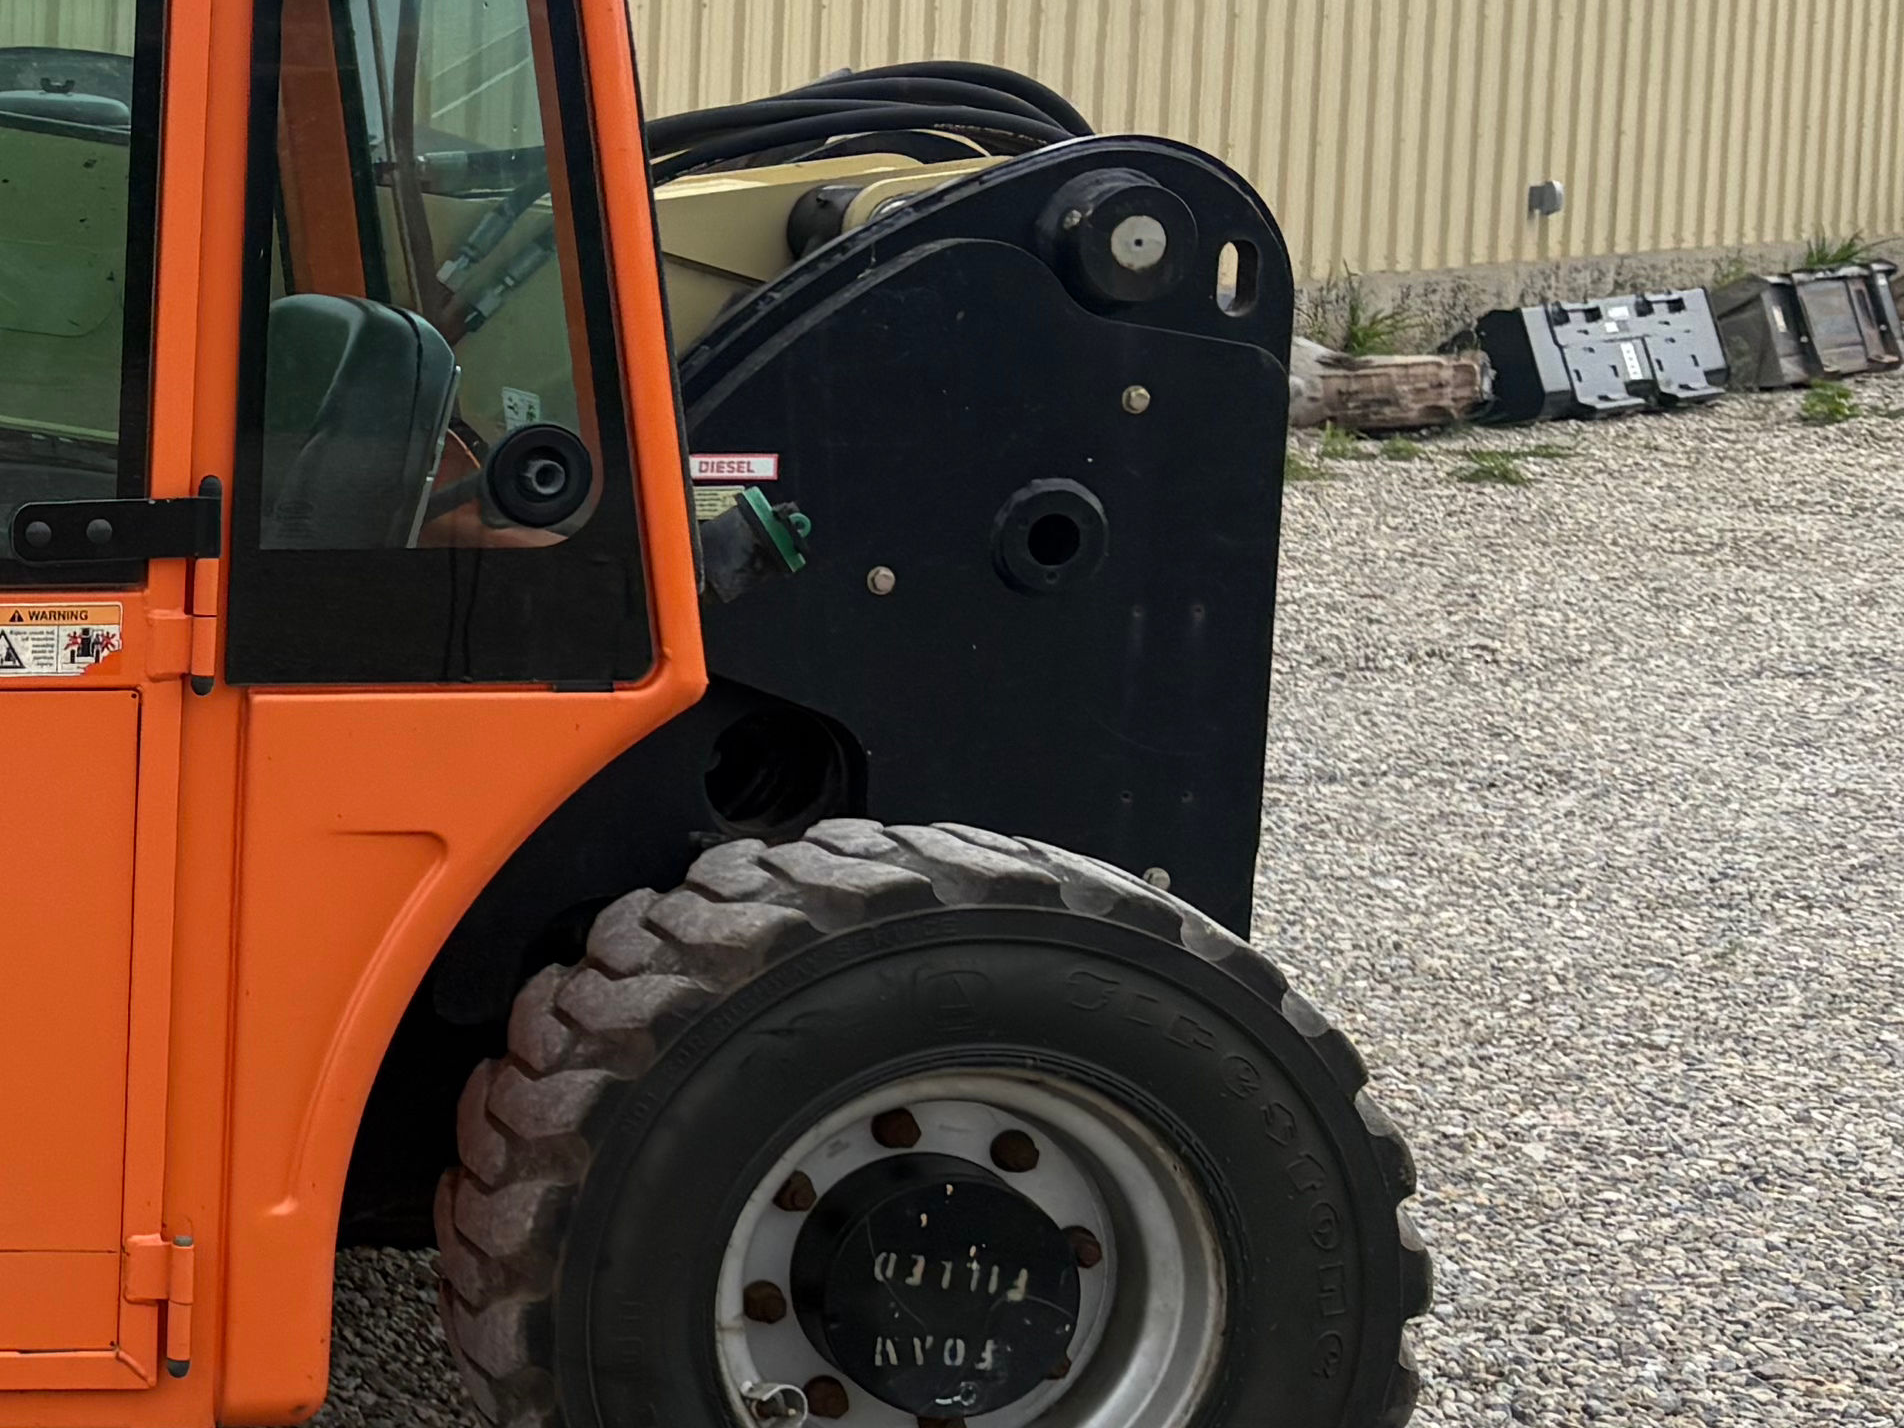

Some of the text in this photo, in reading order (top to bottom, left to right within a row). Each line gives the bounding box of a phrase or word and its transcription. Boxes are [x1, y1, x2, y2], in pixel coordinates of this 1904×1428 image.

[698, 460, 756, 473] DIESEL
[28, 610, 89, 621] WARNING
[874, 1251, 1029, 1301] FILLED
[874, 1335, 996, 1372] FOAM
